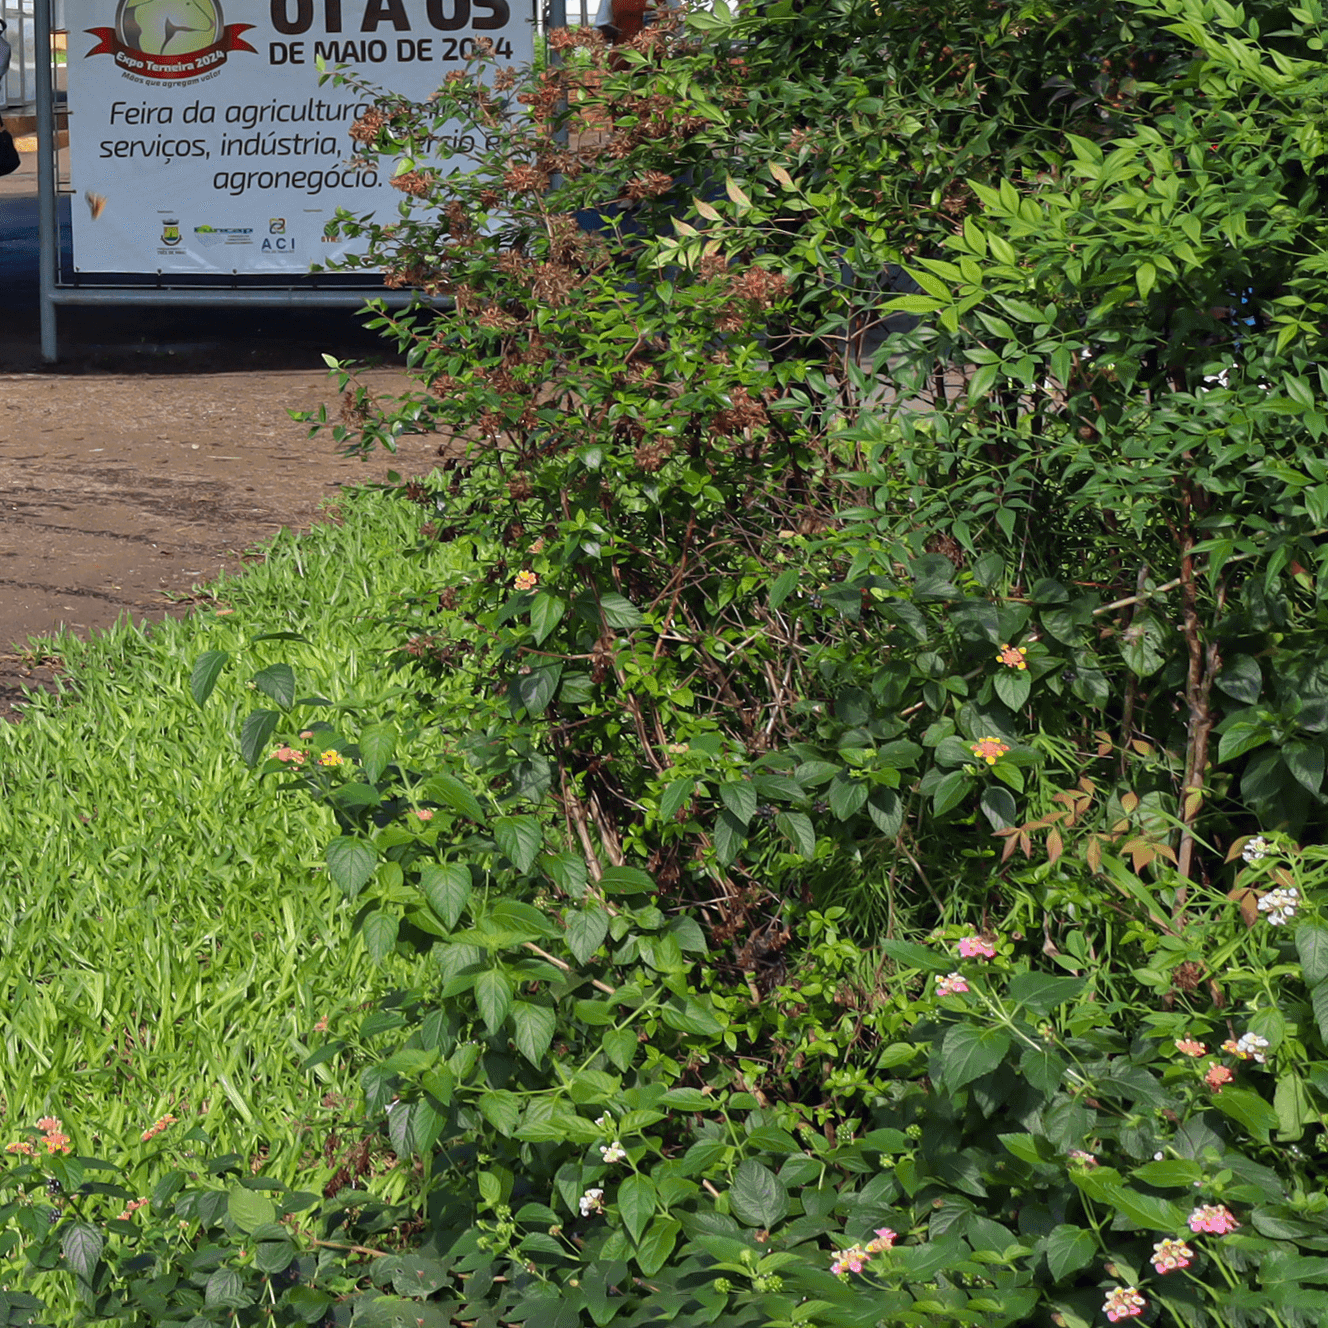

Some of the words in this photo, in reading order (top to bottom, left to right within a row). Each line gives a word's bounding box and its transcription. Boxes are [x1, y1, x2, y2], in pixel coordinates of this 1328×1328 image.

[116, 51, 144, 68] Expo
[146, 61, 195, 72] Terneira
[195, 50, 224, 68] 2024
[269, 41, 305, 65] DE
[314, 40, 387, 63] MAIO
[397, 38, 433, 62] DE
[442, 37, 514, 61] 204
[121, 71, 144, 83] Mãos
[145, 79, 161, 87] que
[162, 78, 200, 88] agregam
[201, 69, 221, 82] valor
[110, 101, 173, 125] Feira
[182, 99, 217, 124] da
[99, 133, 211, 165] serviços,
[220, 131, 342, 158] indústria,
[213, 163, 383, 195] agronegócio.
[261, 238, 295, 250] ACI
